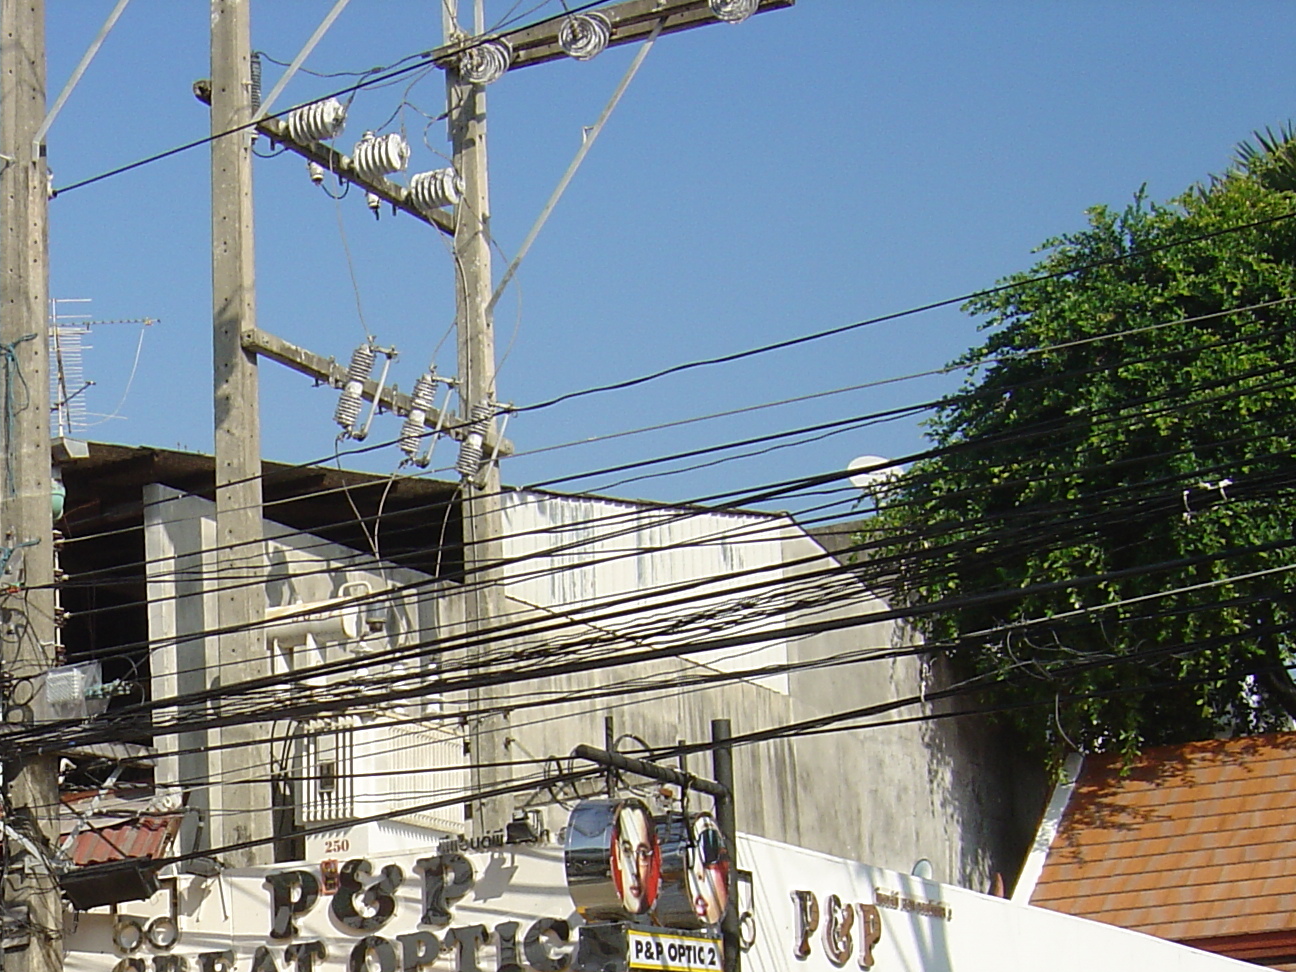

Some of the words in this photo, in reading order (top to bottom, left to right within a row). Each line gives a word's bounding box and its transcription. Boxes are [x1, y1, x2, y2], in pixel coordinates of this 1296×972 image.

[325, 839, 349, 853] 250
[263, 855, 474, 939] P&P
[635, 940, 664, 964] P&P
[667, 943, 704, 965] OPTIC
[707, 947, 716, 965] 2
[790, 890, 881, 971] P&P
